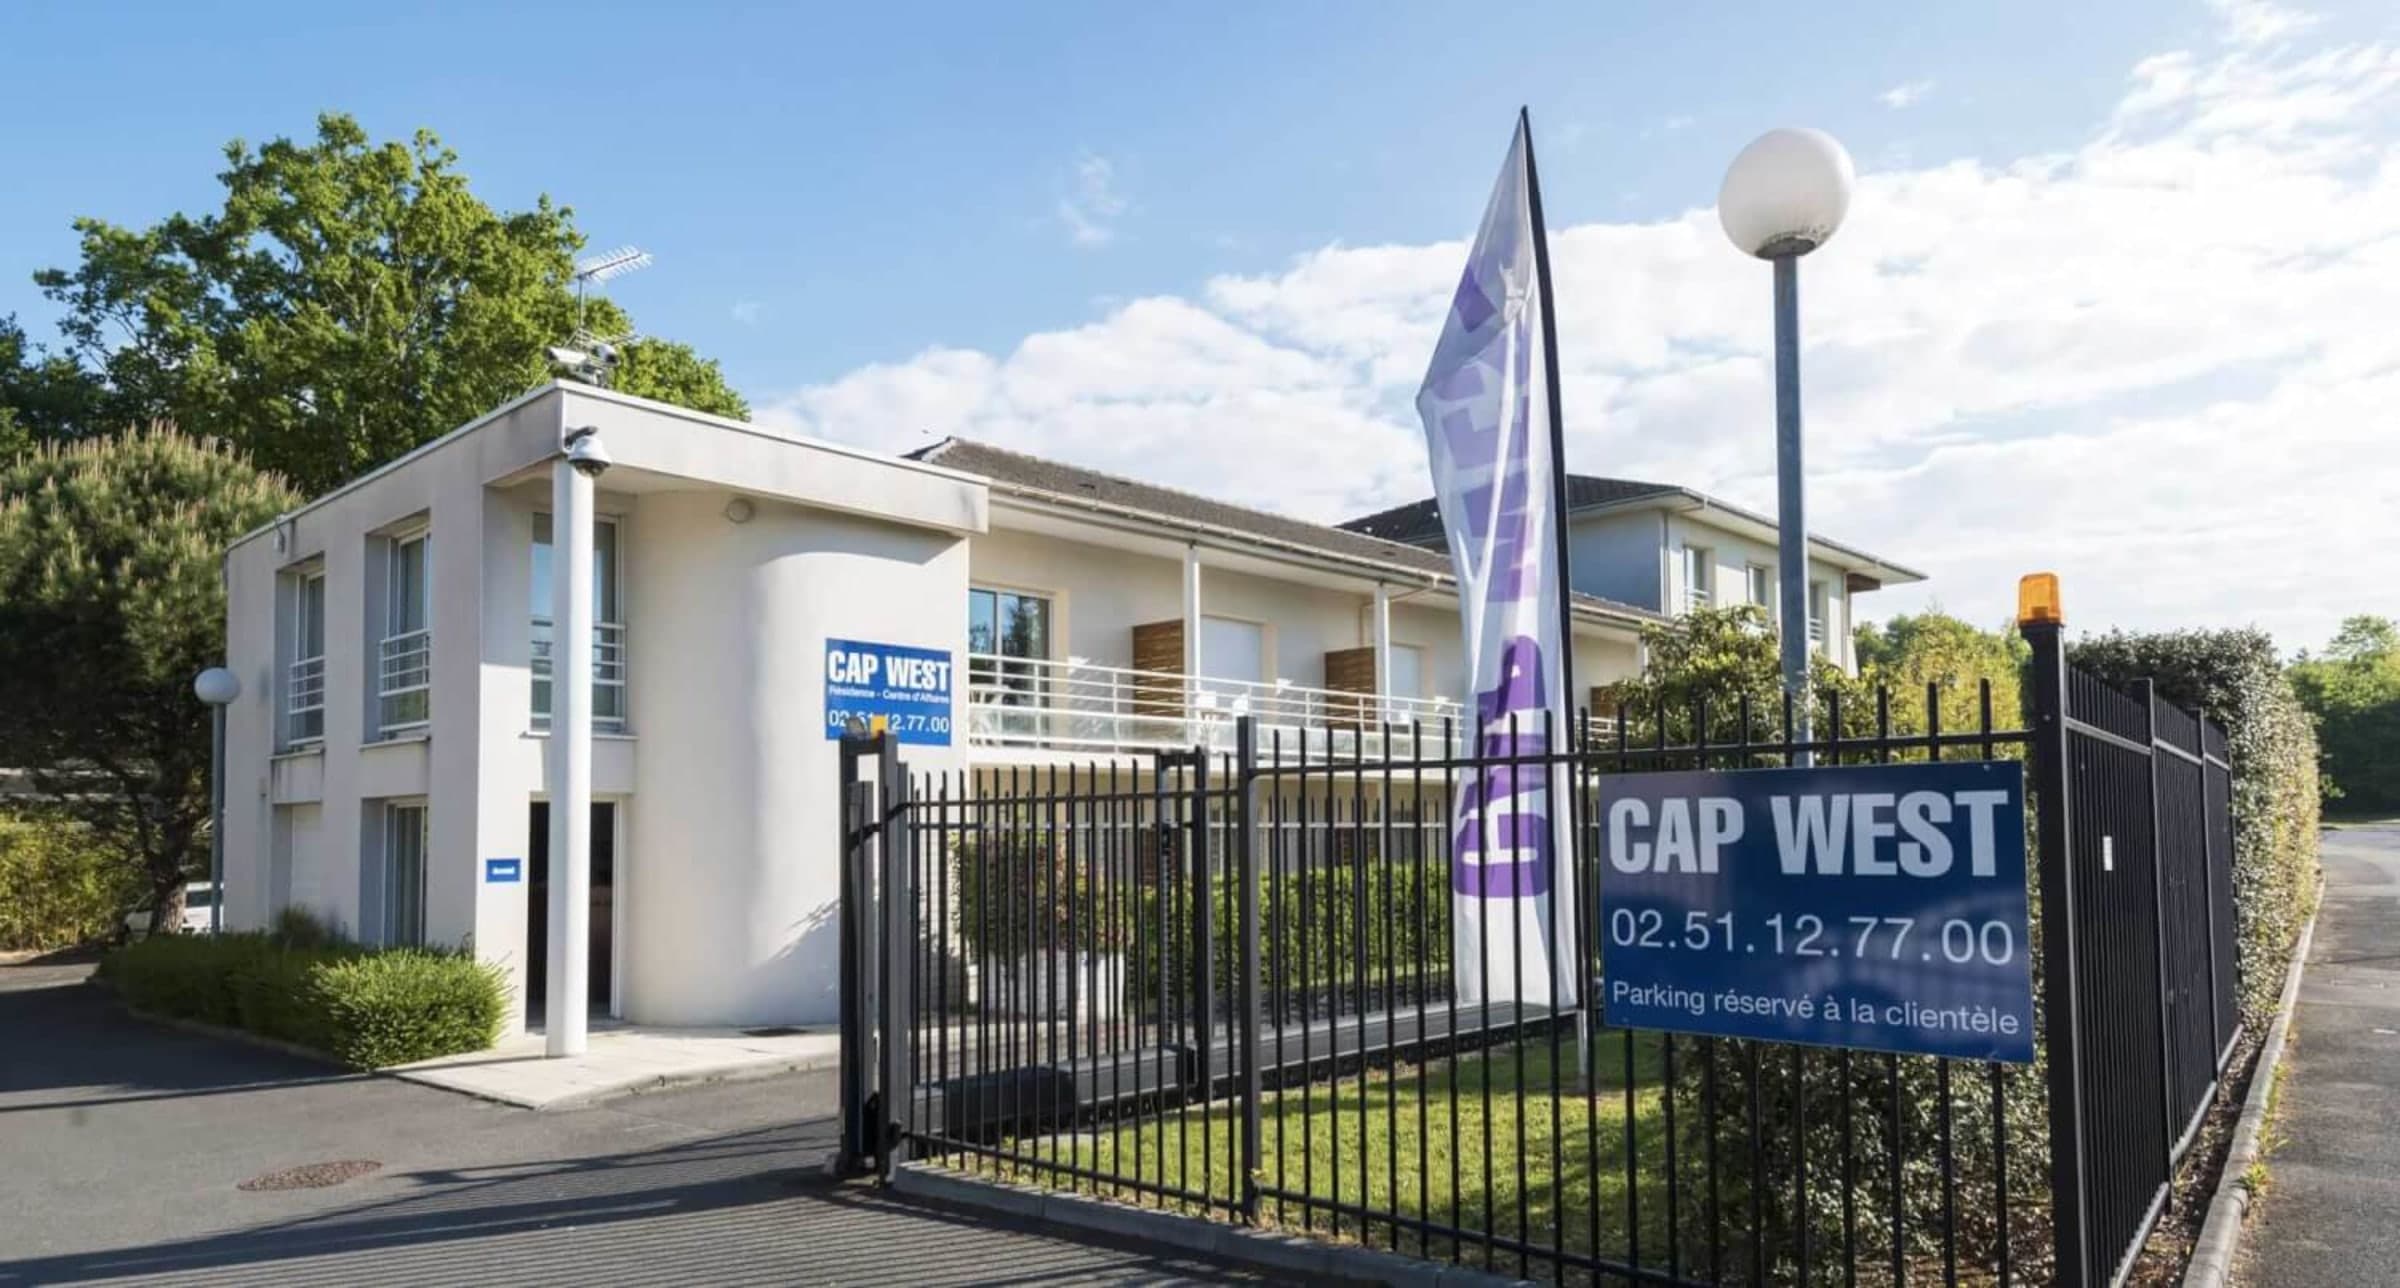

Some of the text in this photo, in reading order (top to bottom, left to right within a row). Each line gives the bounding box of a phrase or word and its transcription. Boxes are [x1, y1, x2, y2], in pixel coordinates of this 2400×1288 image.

[829, 650, 950, 691] CAP WEST
[1608, 790, 2009, 878] CAP WEST
[1611, 908, 2015, 966] 02.51.12.77.00
[1613, 981, 2019, 1035] Parking réservé à la clientèle
